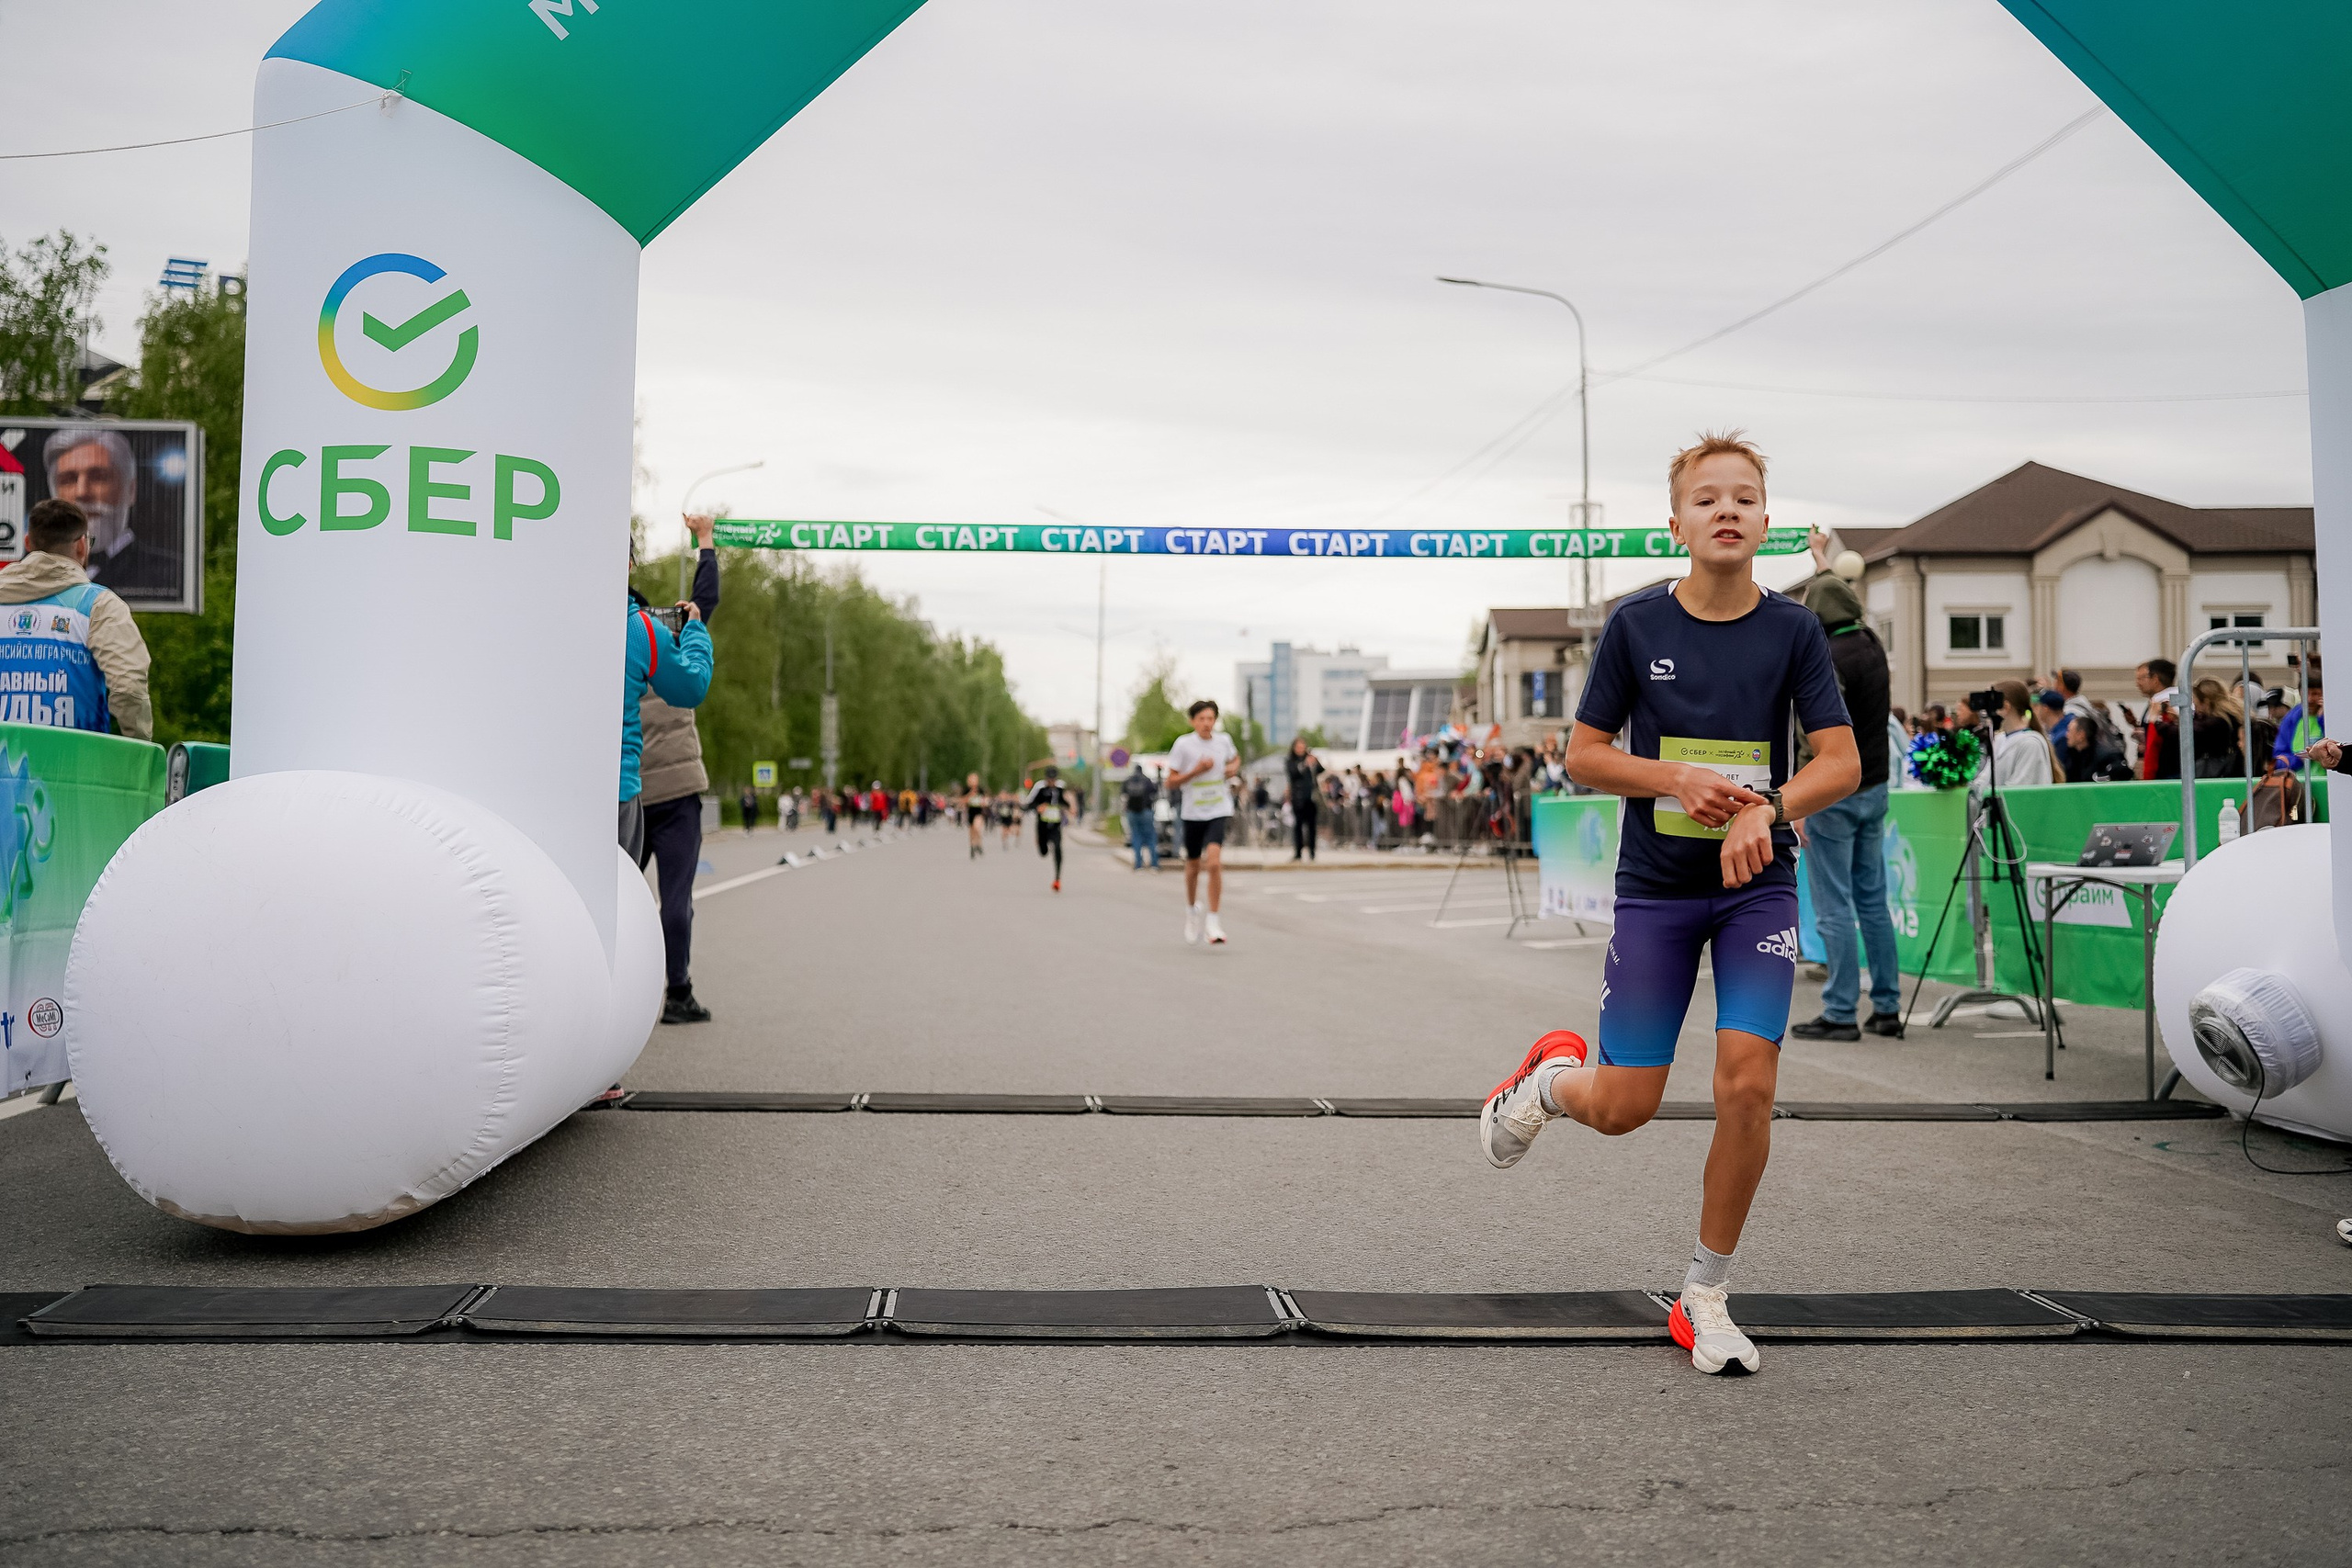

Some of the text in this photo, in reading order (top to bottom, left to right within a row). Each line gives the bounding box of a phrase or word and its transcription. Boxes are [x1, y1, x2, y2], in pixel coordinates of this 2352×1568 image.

[257, 445, 560, 541] СБЕР
[789, 523, 894, 548] СТАРТ
[914, 525, 1019, 550] СТАРТ
[1040, 528, 1145, 553] СТАРТ
[1165, 529, 1268, 555] СТАРТ
[1288, 531, 1389, 557] СТАРТ
[1409, 533, 1508, 557] СТАРТ
[1529, 532, 1626, 557] СТАРТ
[34, 643, 58, 660] ЮГРА
[0, 669, 67, 694] АВНЫЙ
[1756, 942, 1797, 964] adid
